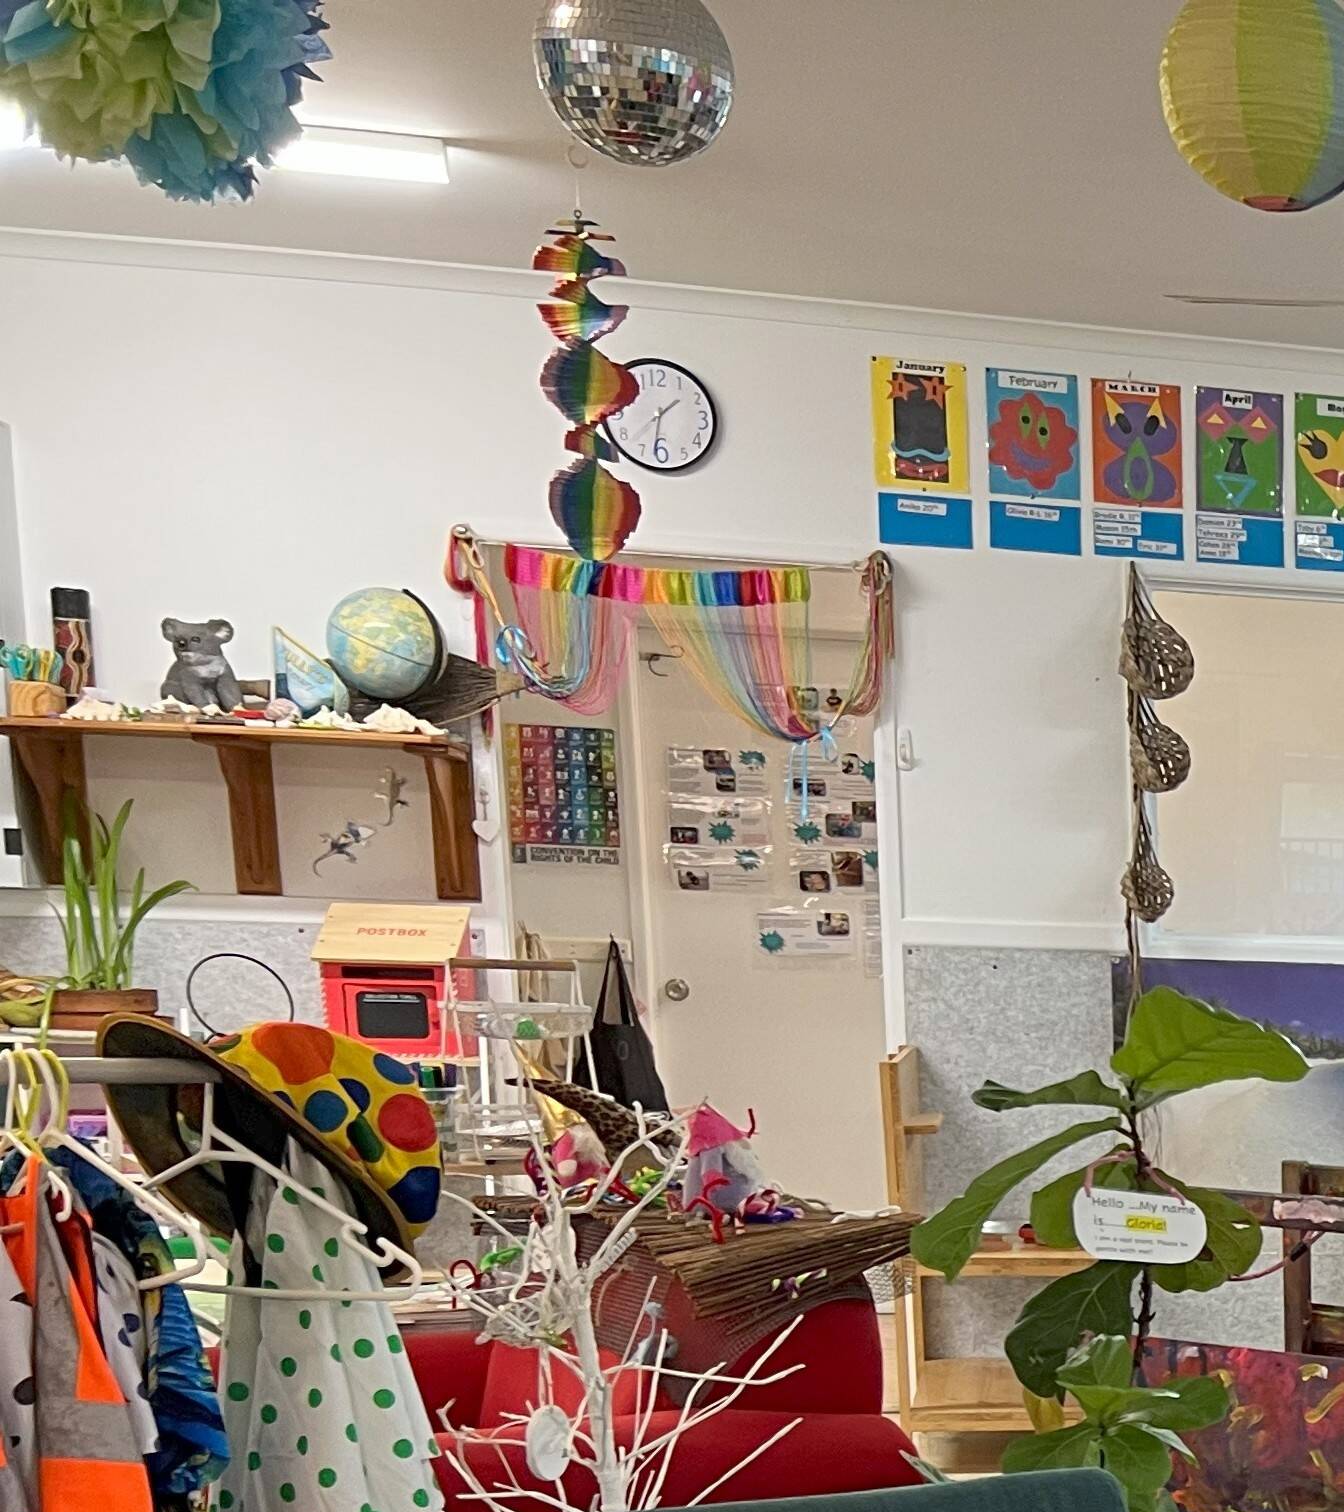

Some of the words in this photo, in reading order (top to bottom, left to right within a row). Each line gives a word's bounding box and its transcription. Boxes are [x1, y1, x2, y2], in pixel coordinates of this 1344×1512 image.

[896, 360, 945, 374] January
[1008, 375, 1058, 390] February
[1109, 383, 1157, 393] MARCH
[694, 392, 701, 405] 2
[1225, 393, 1251, 405] April
[698, 410, 708, 430] 3
[620, 427, 628, 441] 8
[692, 431, 702, 449] 4
[638, 443, 646, 457] 7
[654, 438, 669, 464] 6
[680, 447, 688, 460] 5
[357, 928, 427, 937] POSTBOX
[1092, 1198, 1124, 1208] Hello
[1163, 1205, 1196, 1215] name
